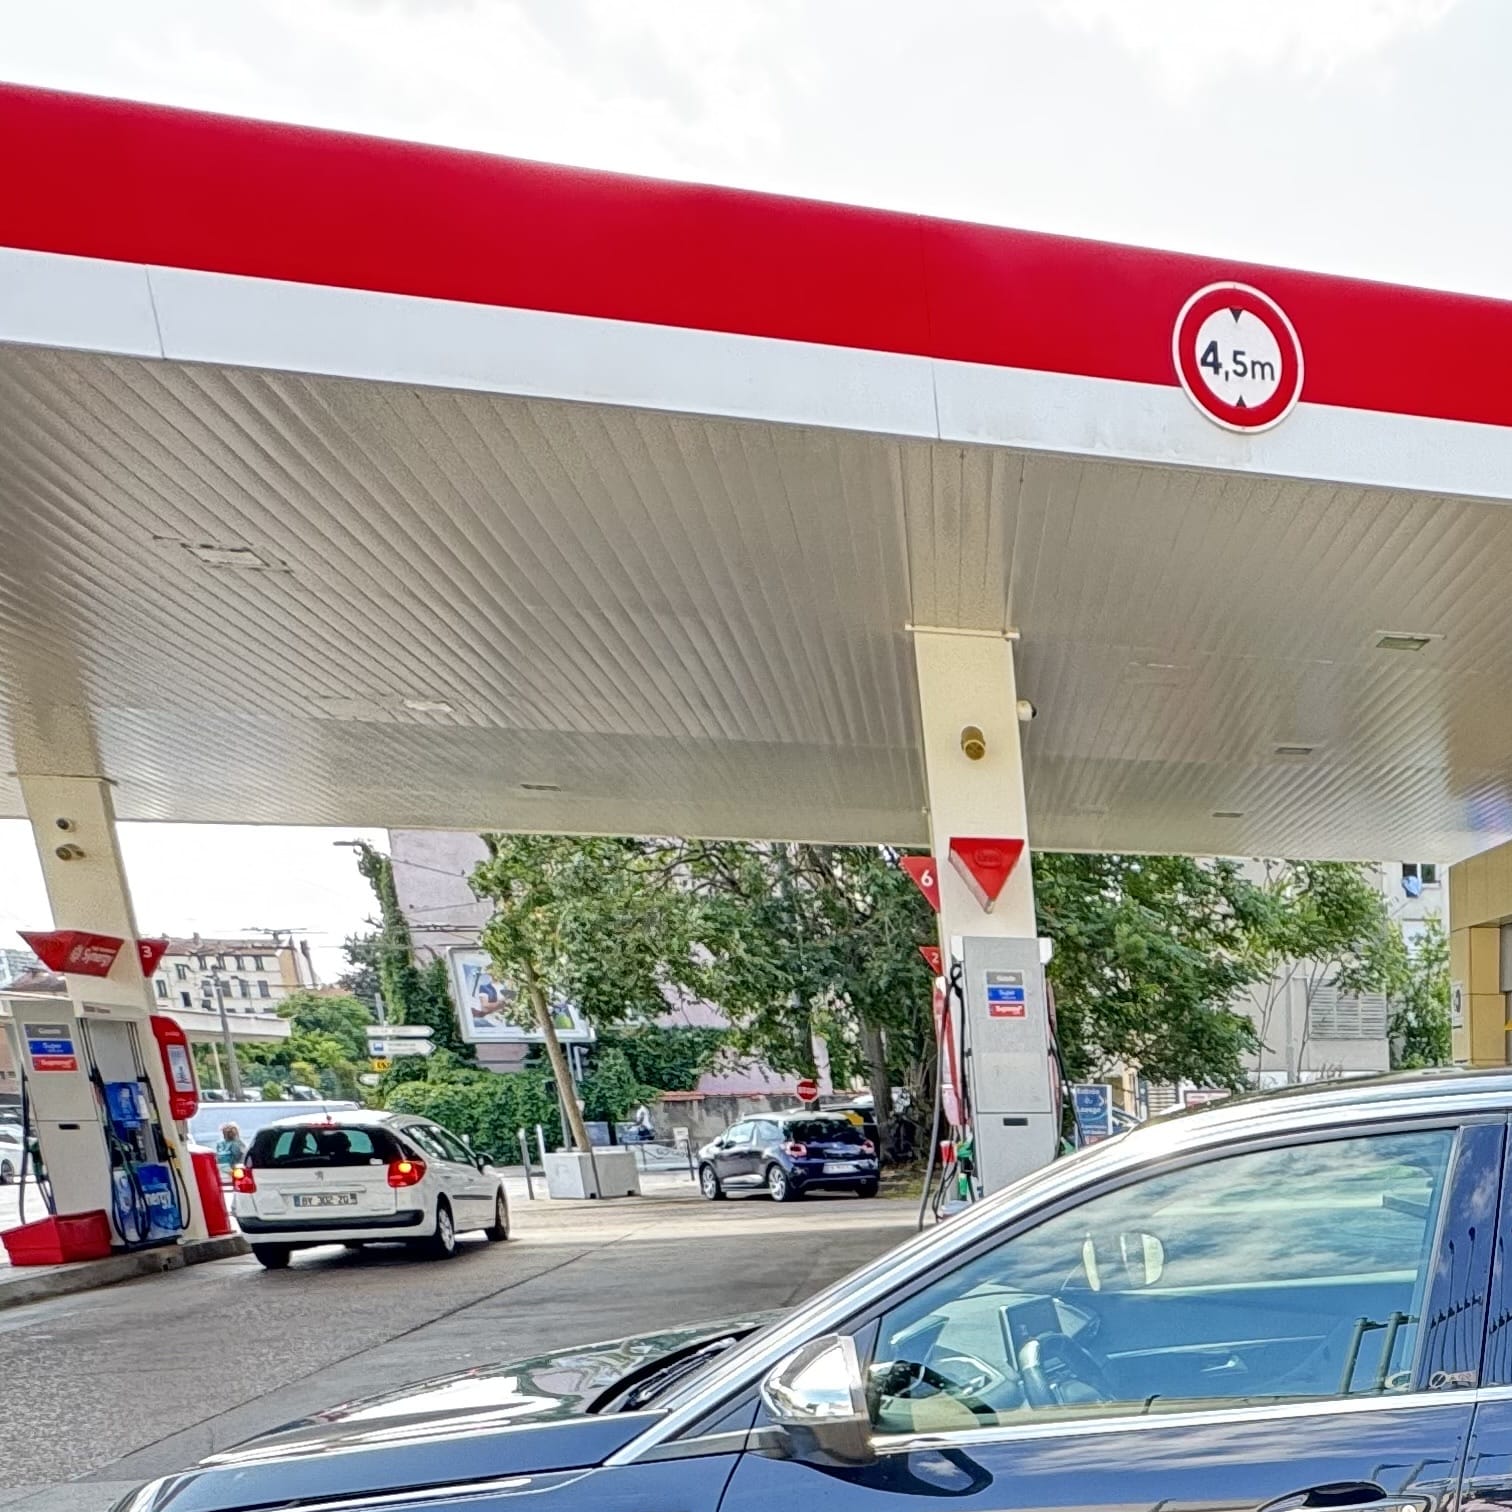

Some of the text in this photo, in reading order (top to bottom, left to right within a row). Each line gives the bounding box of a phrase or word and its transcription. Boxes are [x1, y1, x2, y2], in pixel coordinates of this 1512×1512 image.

[1200, 340, 1275, 382] 4,5m
[921, 869, 934, 887] 6
[141, 945, 153, 959] 3
[931, 952, 940, 964] 2
